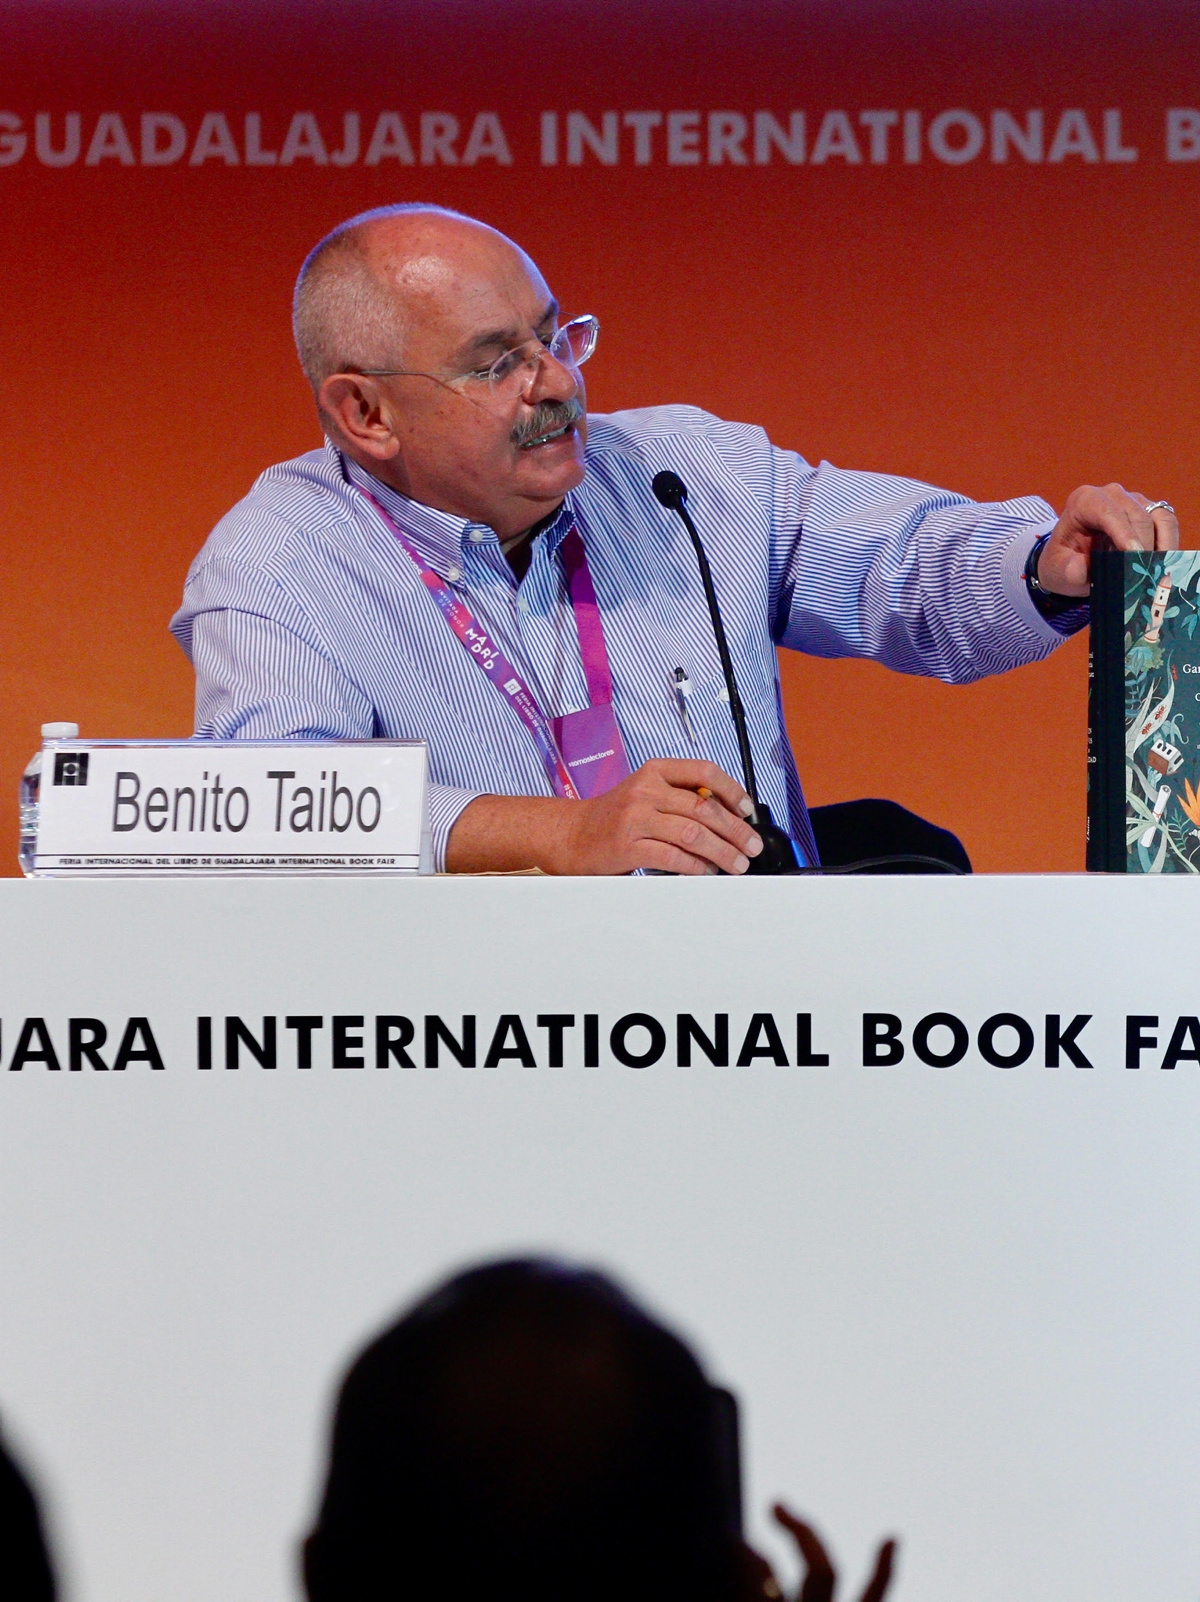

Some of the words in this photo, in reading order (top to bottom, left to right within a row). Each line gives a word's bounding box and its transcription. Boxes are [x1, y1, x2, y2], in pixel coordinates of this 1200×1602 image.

[540, 106, 1139, 166] INTERNATIONAL
[112, 771, 249, 833] Benito
[266, 770, 381, 833] Taibo
[0, 1017, 165, 1071] ARA
[197, 1012, 829, 1070] INTERNATIONAL
[862, 1012, 1094, 1068] BOOK
